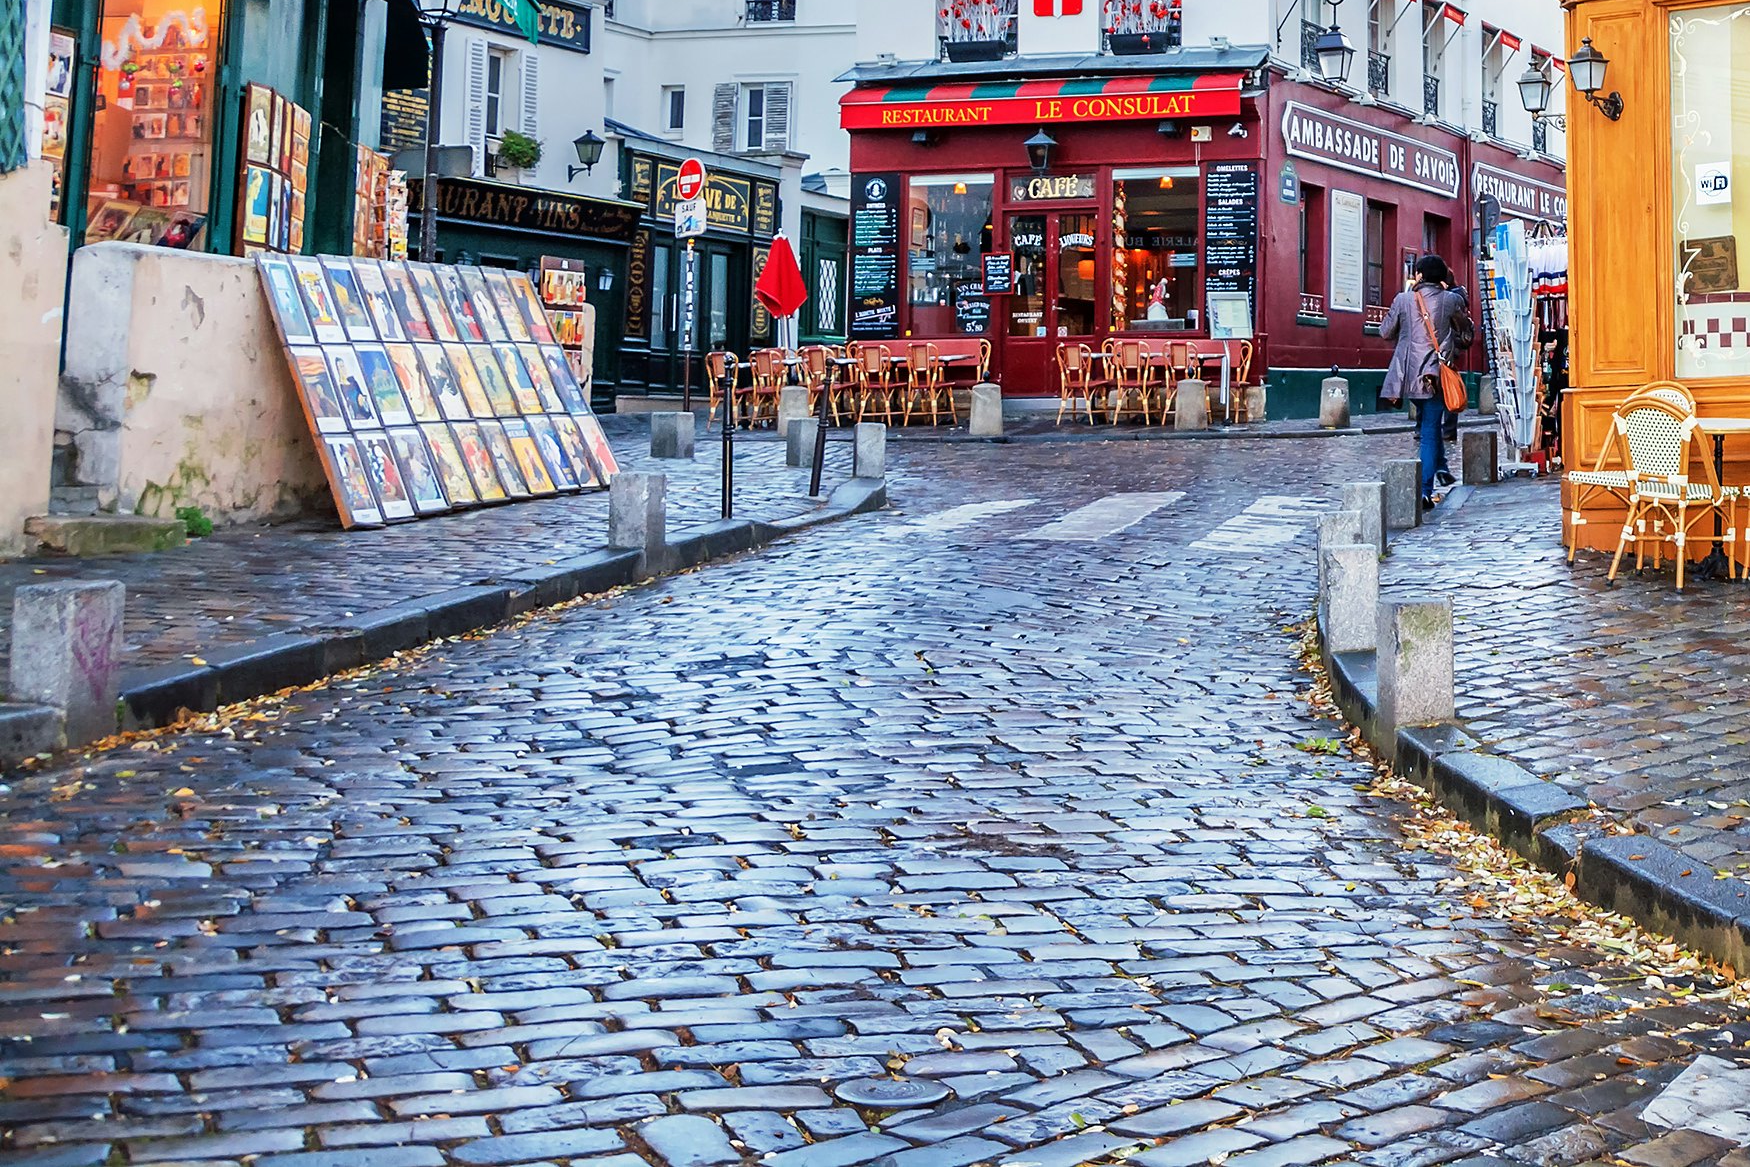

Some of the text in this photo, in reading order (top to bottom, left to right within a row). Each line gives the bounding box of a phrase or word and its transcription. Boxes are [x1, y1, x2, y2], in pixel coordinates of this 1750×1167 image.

[882, 95, 1195, 124] RESTAURANT LE CONSULAT
[1290, 115, 1456, 187] AMBASSADE DE SAVOIE
[1028, 174, 1078, 199] CAFÉ
[1476, 173, 1536, 209] RESTAURANT
[1540, 192, 1550, 213] LE
[724, 194, 736, 210] DE
